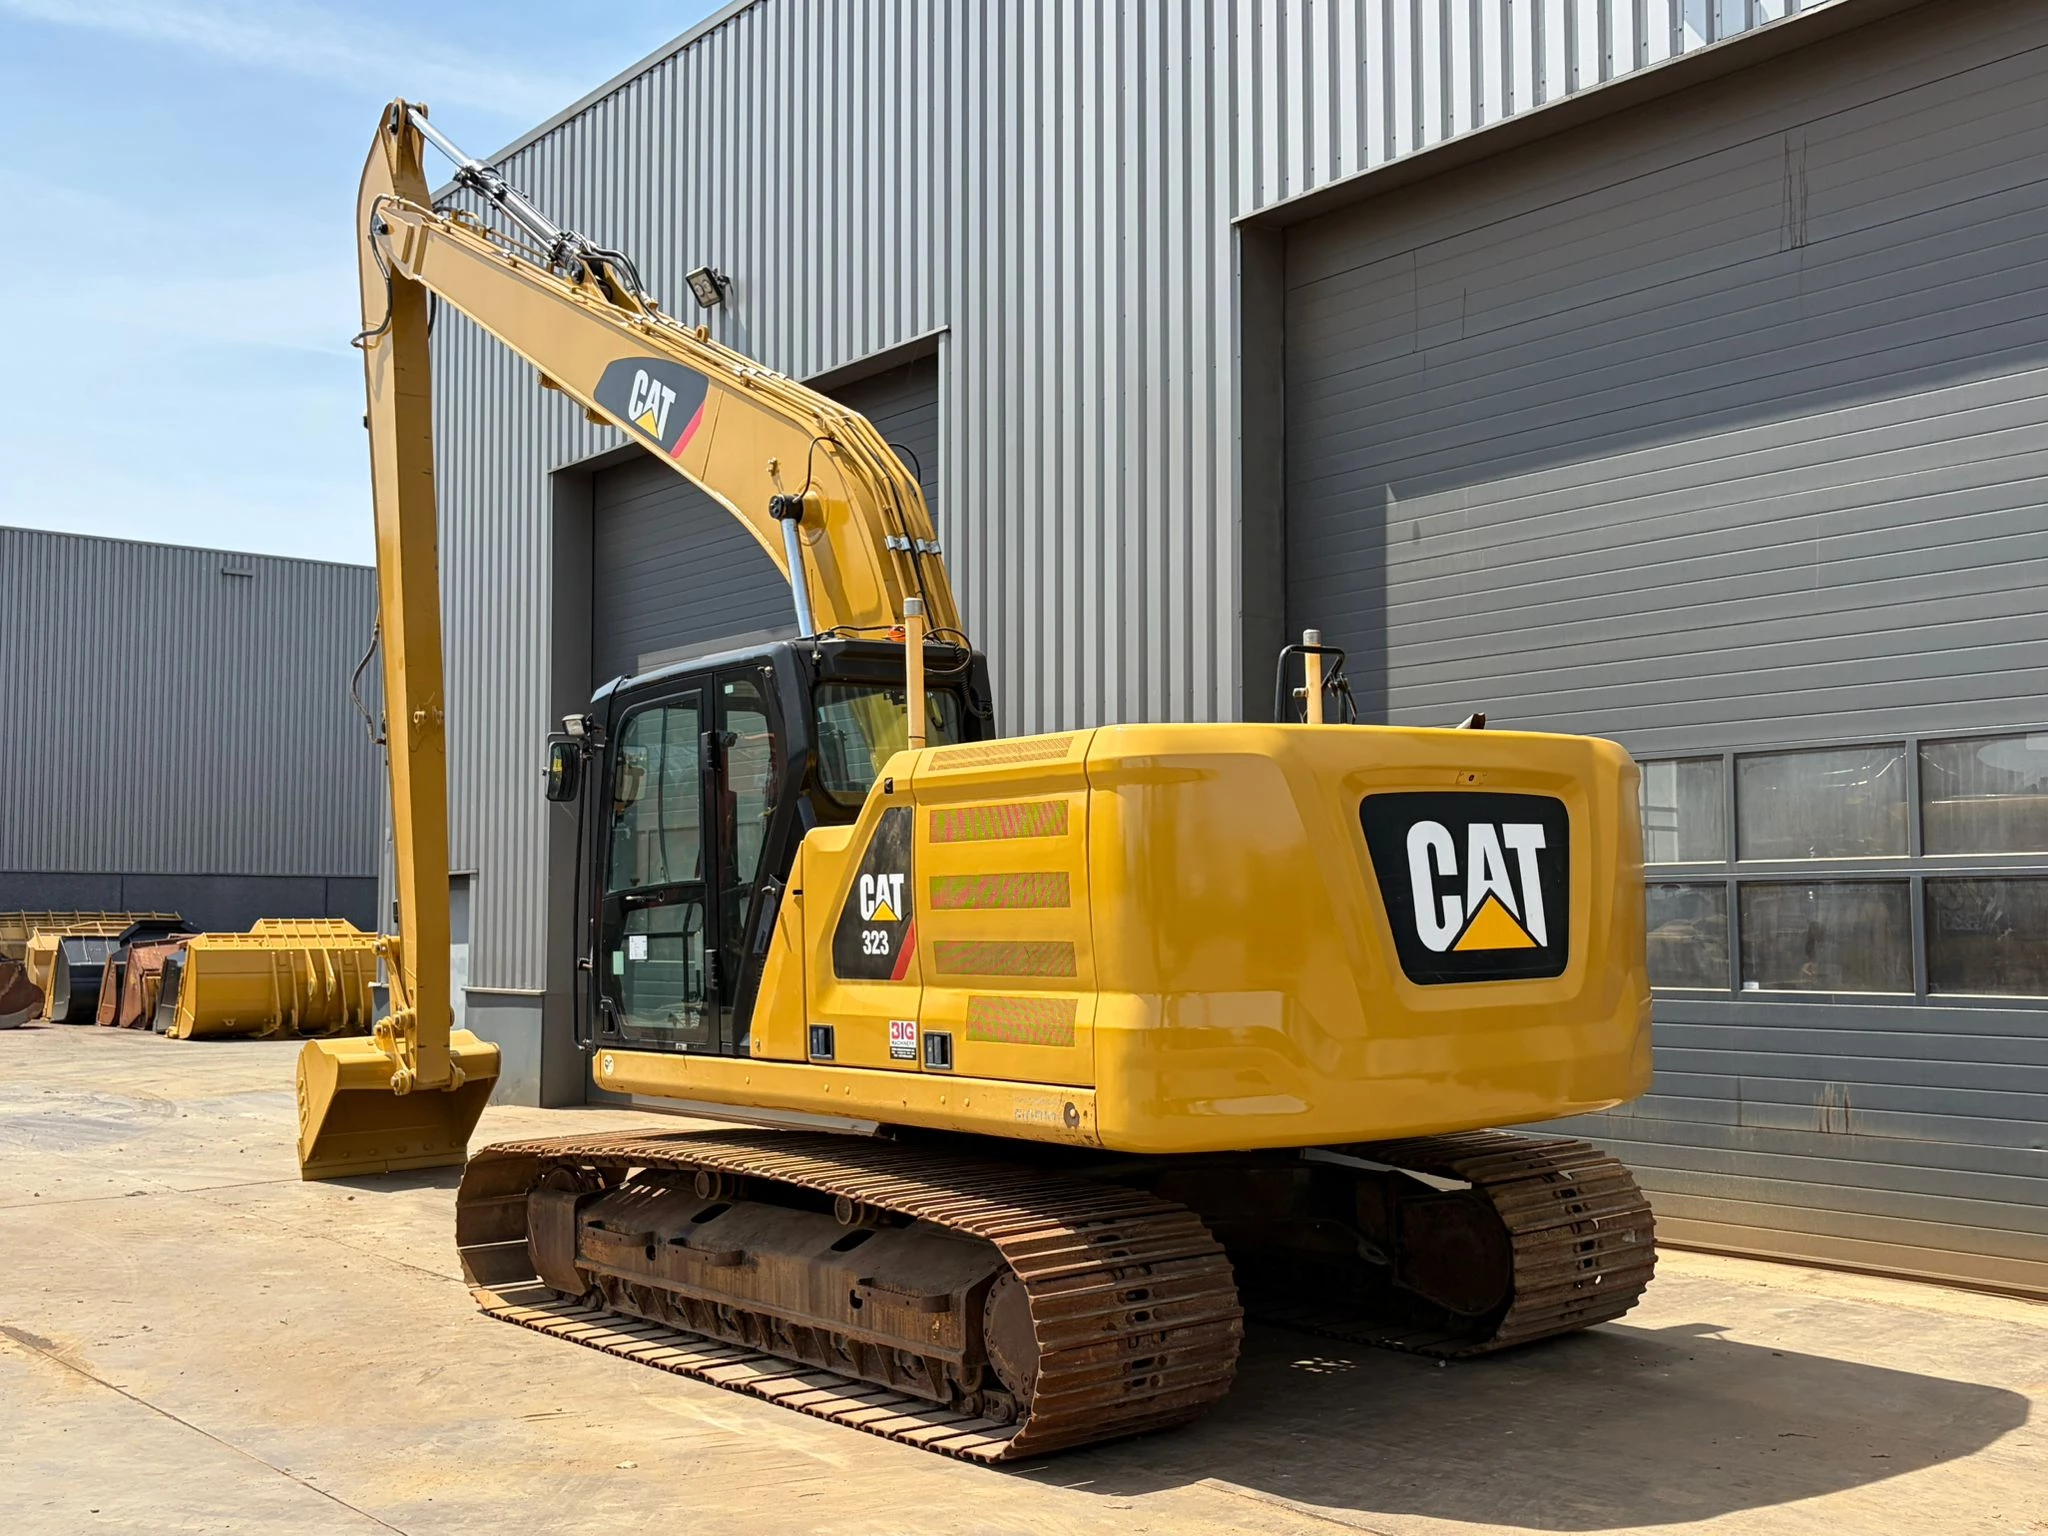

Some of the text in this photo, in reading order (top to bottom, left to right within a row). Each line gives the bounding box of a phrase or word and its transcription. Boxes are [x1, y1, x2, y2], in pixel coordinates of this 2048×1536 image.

[628, 369, 677, 441] CAT
[860, 873, 904, 921] CAT
[1406, 820, 1548, 952] CAT
[862, 930, 889, 955] 323
